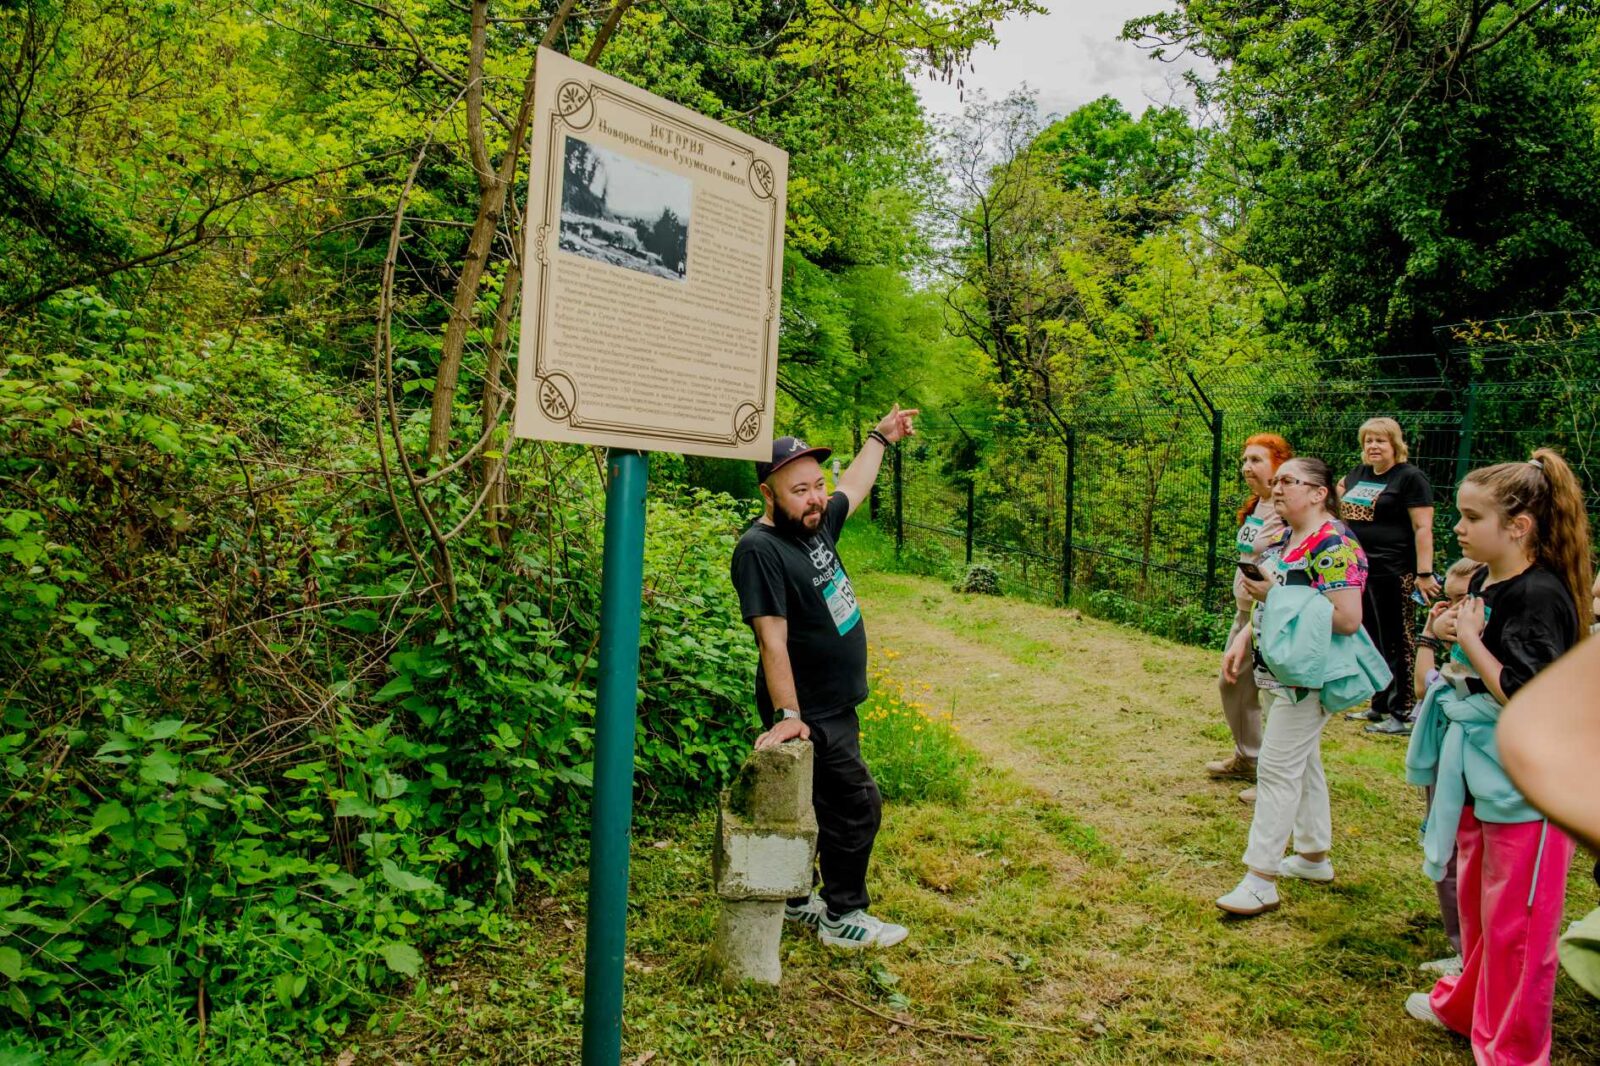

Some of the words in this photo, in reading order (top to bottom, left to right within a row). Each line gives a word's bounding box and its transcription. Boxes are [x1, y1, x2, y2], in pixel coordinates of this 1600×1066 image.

[599, 119, 722, 176] Новороссийско-Сухумского
[722, 172, 745, 186] шоссе
[651, 124, 704, 155] ИСТОРИЯ
